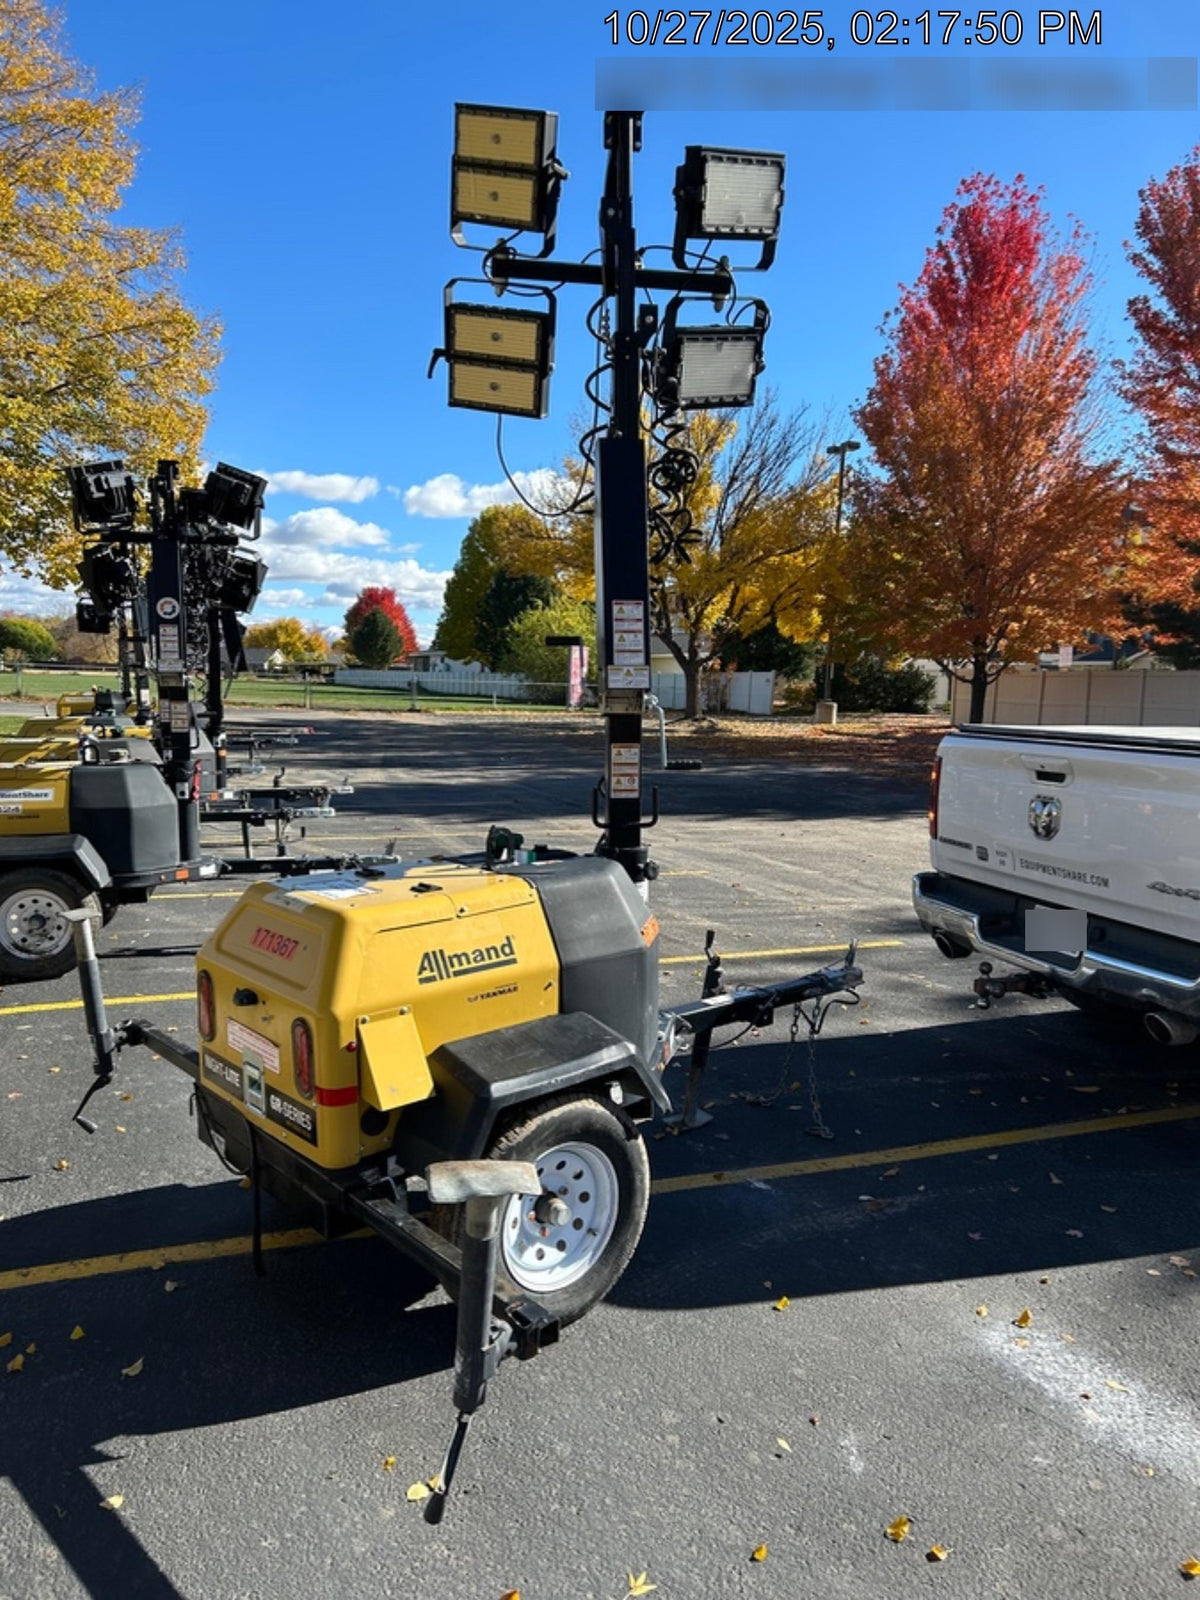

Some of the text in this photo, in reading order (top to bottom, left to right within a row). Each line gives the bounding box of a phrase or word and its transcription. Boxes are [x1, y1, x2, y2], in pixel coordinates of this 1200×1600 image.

[1019, 858, 1109, 888] EQUIPMENTSHARE.COM
[251, 926, 300, 960] 171367
[417, 935, 515, 981] Allmand
